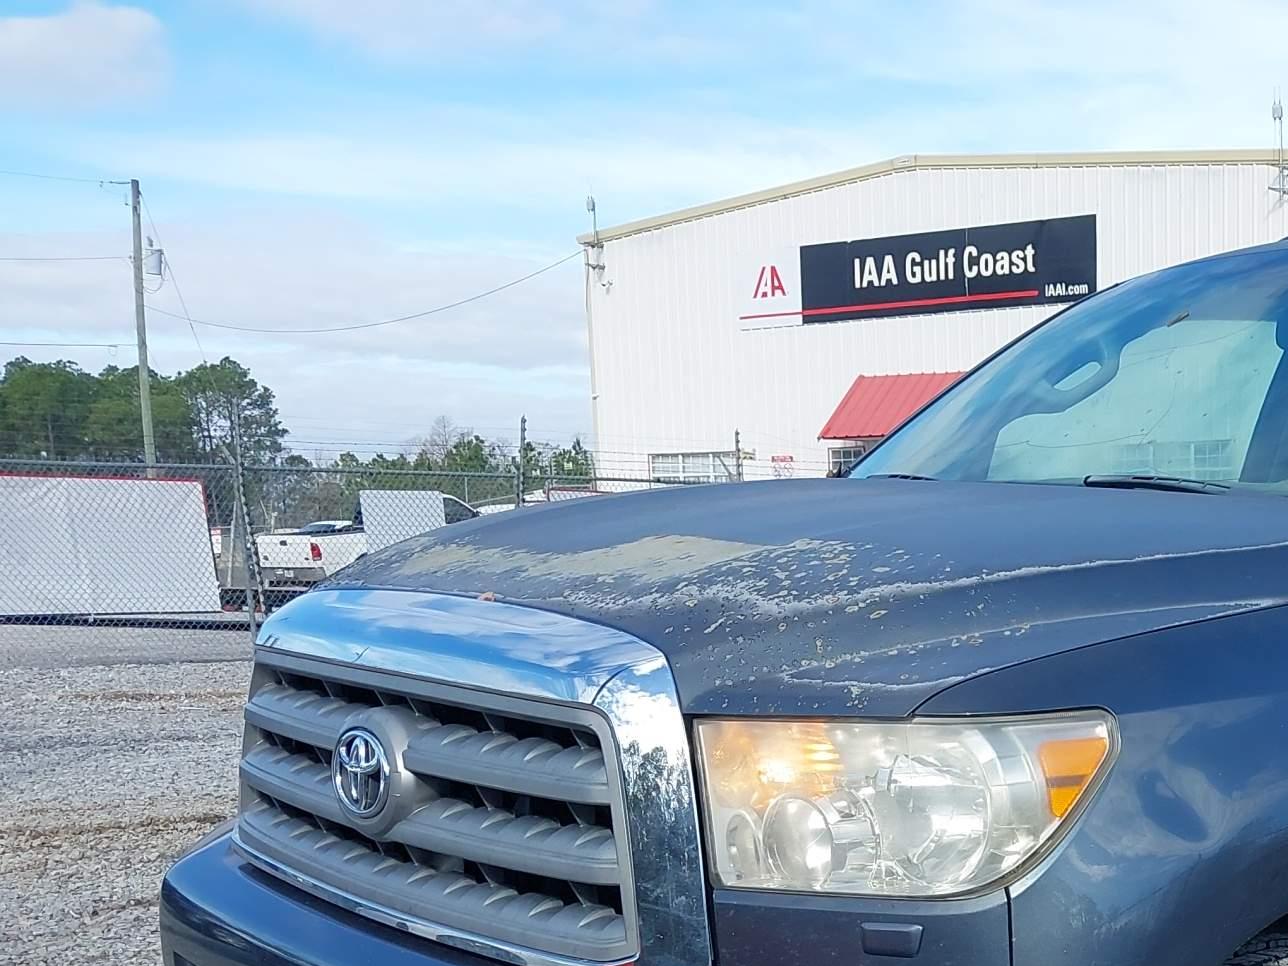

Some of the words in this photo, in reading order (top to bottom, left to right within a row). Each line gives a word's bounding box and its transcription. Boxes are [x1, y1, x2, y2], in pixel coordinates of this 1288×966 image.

[854, 254, 899, 289] IAA
[905, 248, 956, 284] Gulf
[963, 243, 1036, 279] Coast
[1045, 282, 1089, 298] IAAI.com
